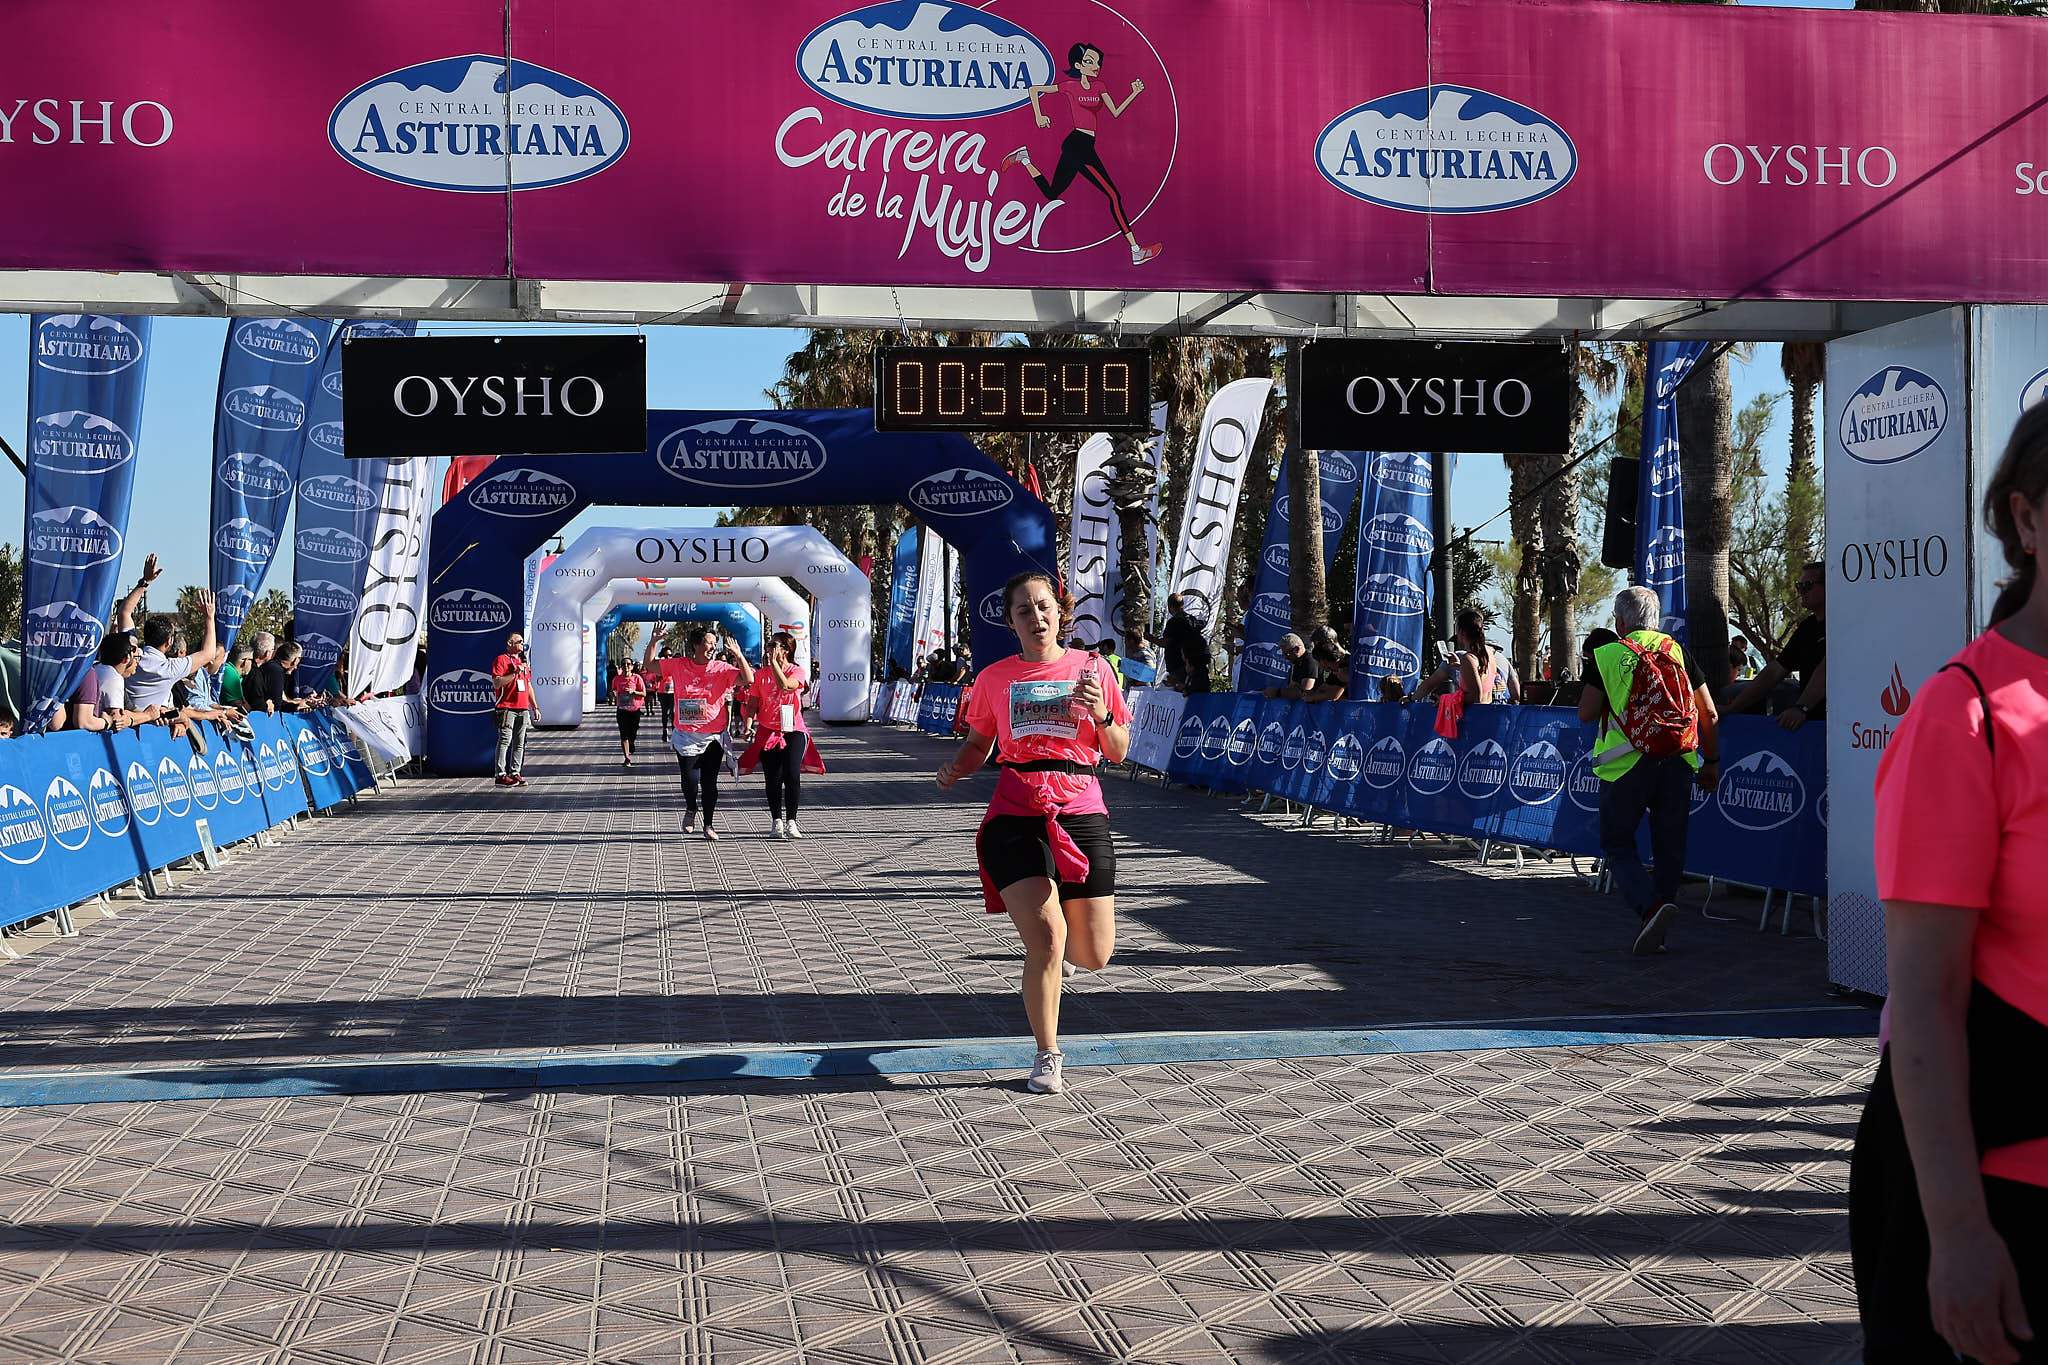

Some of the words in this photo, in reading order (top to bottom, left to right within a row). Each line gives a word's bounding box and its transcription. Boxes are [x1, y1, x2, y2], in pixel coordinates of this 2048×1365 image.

[857, 36, 937, 52] CENTRAL
[946, 40, 1028, 55] LECHERA
[817, 38, 1034, 90] ASTURIANA
[399, 101, 492, 115] CENTRAL
[352, 103, 608, 157] ASTURIANA
[774, 106, 988, 175] Carrera
[1376, 128, 1458, 142] CENTRAL
[1466, 130, 1549, 144] LECHERA
[1336, 129, 1557, 181] ASTURIANA
[1703, 143, 1898, 188] OYSHO
[827, 174, 867, 218] de
[875, 173, 904, 220] la
[898, 168, 1066, 273] Mujer
[241, 328, 314, 358] ASTURIANA
[393, 375, 604, 417] OYSHO
[896, 361, 1129, 416] 00:56:49
[1346, 375, 1532, 418] OYSHO
[229, 394, 302, 425] ASTURIANA
[1861, 400, 1895, 415] CENTRAL
[1897, 391, 1936, 407] LECHERA
[1846, 405, 1940, 446] ASTURIANA
[670, 439, 815, 470] ASTURIANA
[696, 438, 750, 447] CENTRAL
[754, 439, 809, 447] LECHERA
[304, 482, 371, 507] ASTURIANA
[475, 486, 568, 506] ASTURIANA
[918, 486, 1008, 505] ASTURIANA
[636, 537, 770, 563] OYSHO
[1842, 535, 1948, 582] OYSHO
[555, 568, 596, 577] OYSHO
[807, 565, 847, 574] OYSHO
[896, 564, 918, 624] Marlene
[433, 606, 506, 623] ASTURIANA
[537, 622, 575, 631] OYSHO
[828, 620, 865, 629] OYSHO
[536, 676, 575, 687] OYSHO
[828, 672, 865, 682] OYSHO
[1461, 760, 1502, 784] ASTURIANA
[1512, 762, 1560, 790] ASTURIANA
[1721, 775, 1793, 813] ASTURIANA
